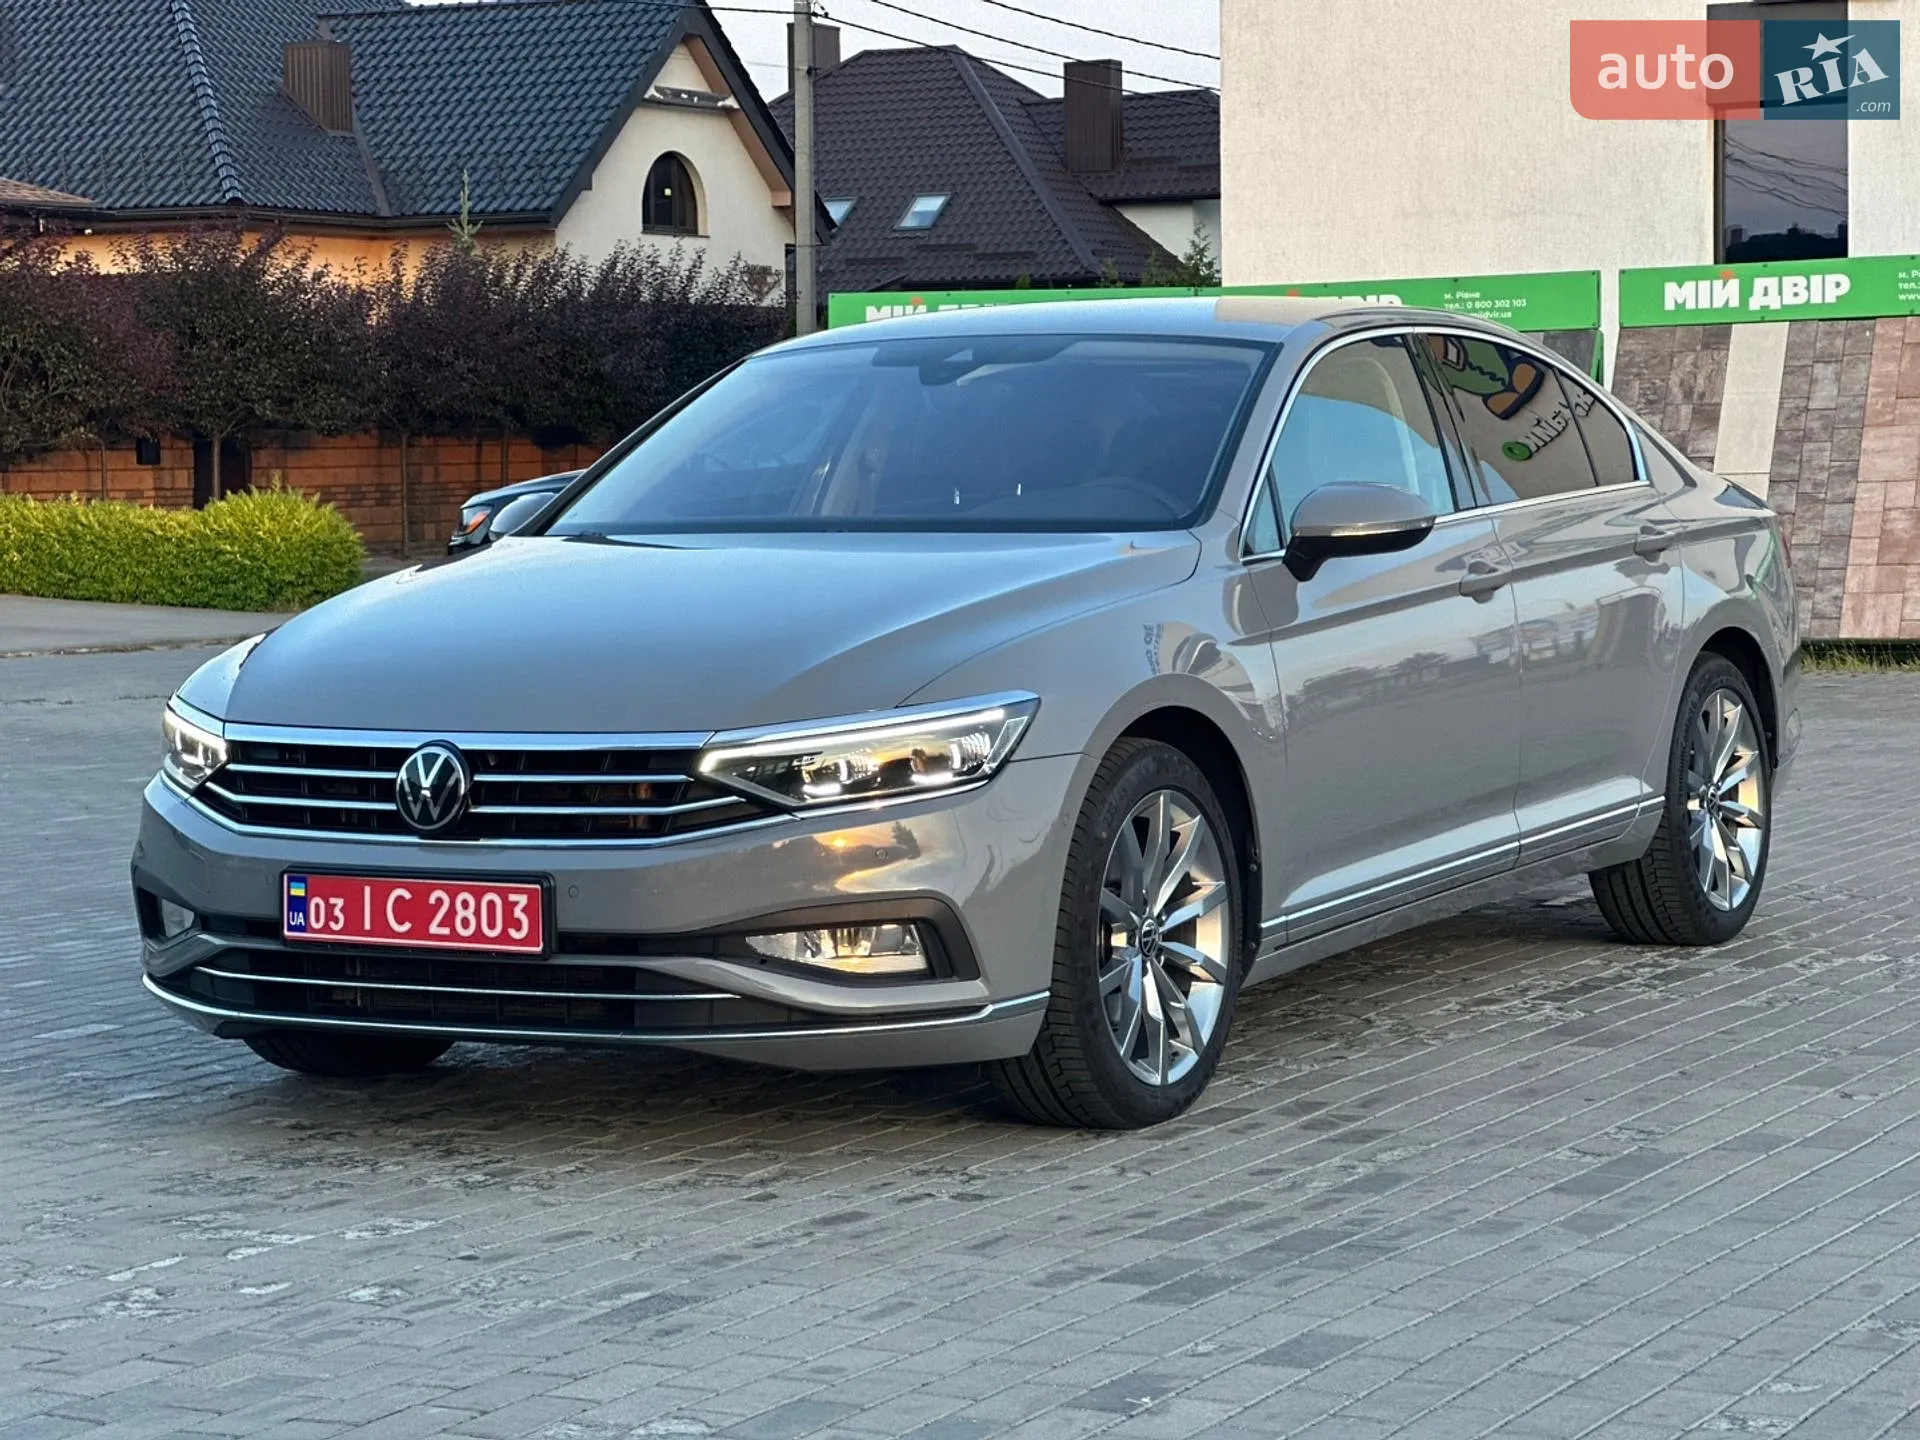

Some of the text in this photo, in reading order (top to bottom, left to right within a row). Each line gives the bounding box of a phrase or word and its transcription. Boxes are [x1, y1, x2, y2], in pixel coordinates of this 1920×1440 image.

[1466, 301, 1474, 309] 0
[1475, 300, 1493, 309] 800
[1494, 299, 1510, 308] 302
[1512, 298, 1527, 307] 103
[1664, 270, 1851, 311] МІЙ ДВІР
[289, 911, 306, 927] UA
[309, 896, 345, 932] 03
[428, 889, 530, 940] 2803
